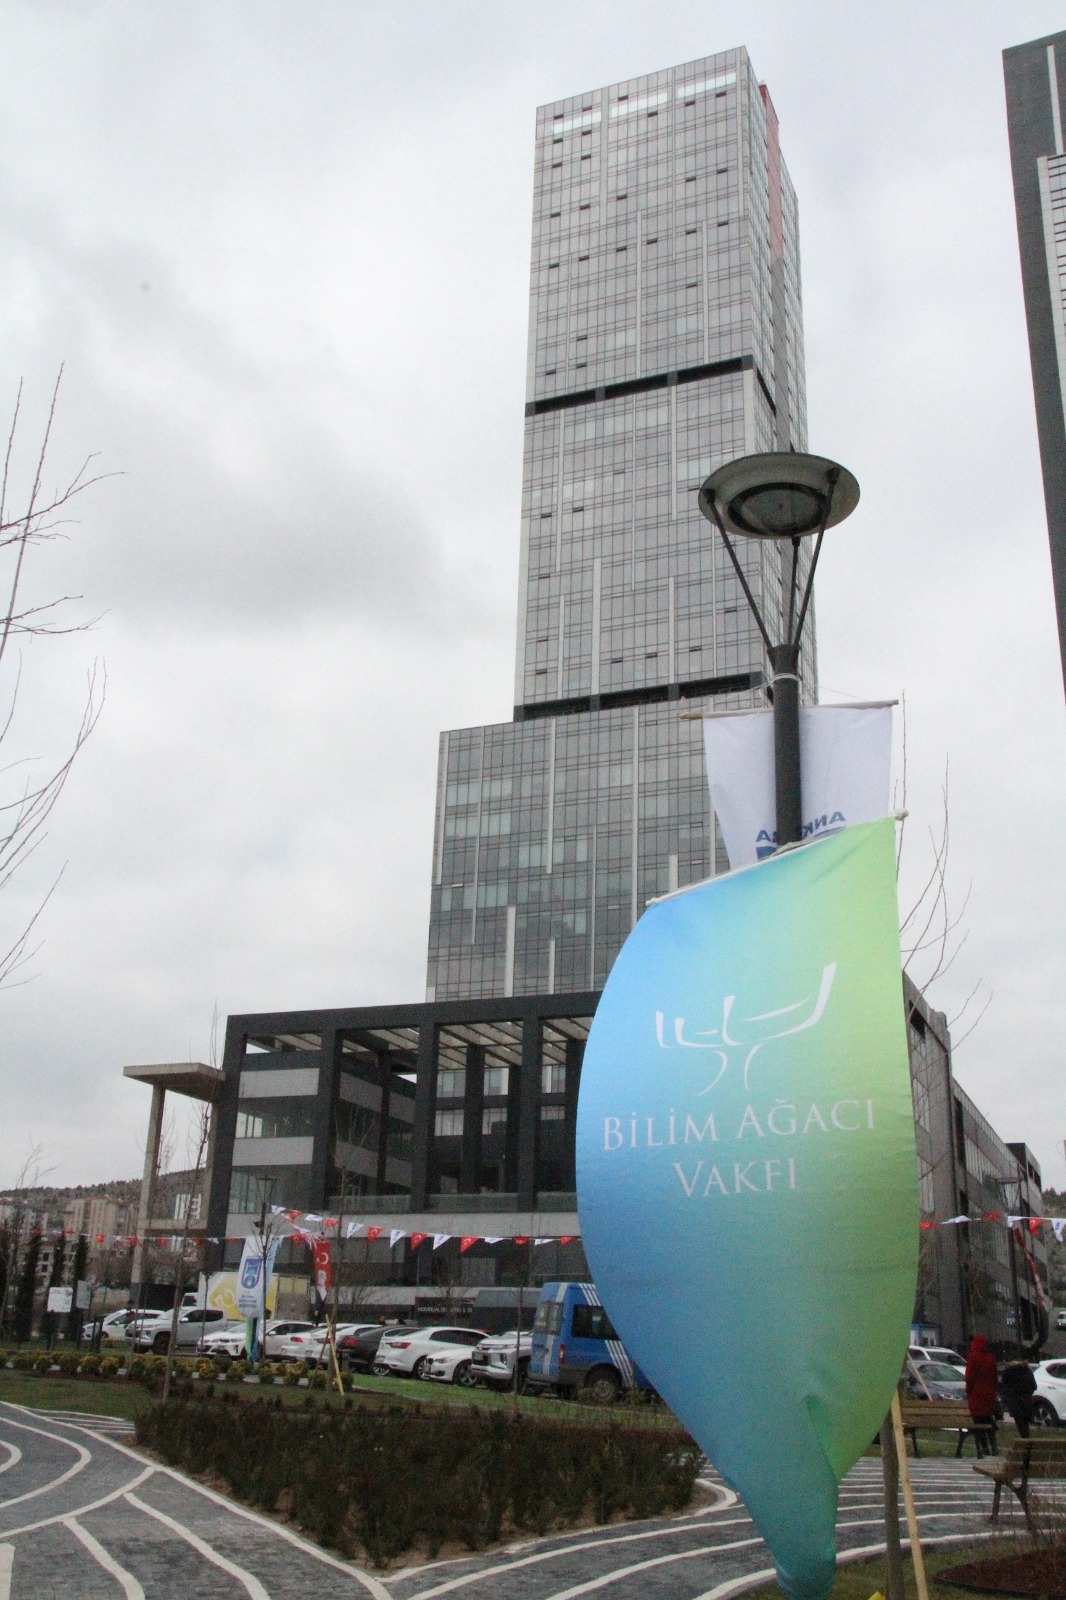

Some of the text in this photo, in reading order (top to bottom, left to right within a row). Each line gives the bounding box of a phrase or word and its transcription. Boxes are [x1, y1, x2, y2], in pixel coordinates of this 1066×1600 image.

[603, 1098, 876, 1150] BİLİM AĞACI
[673, 1157, 798, 1197] VAKFI
